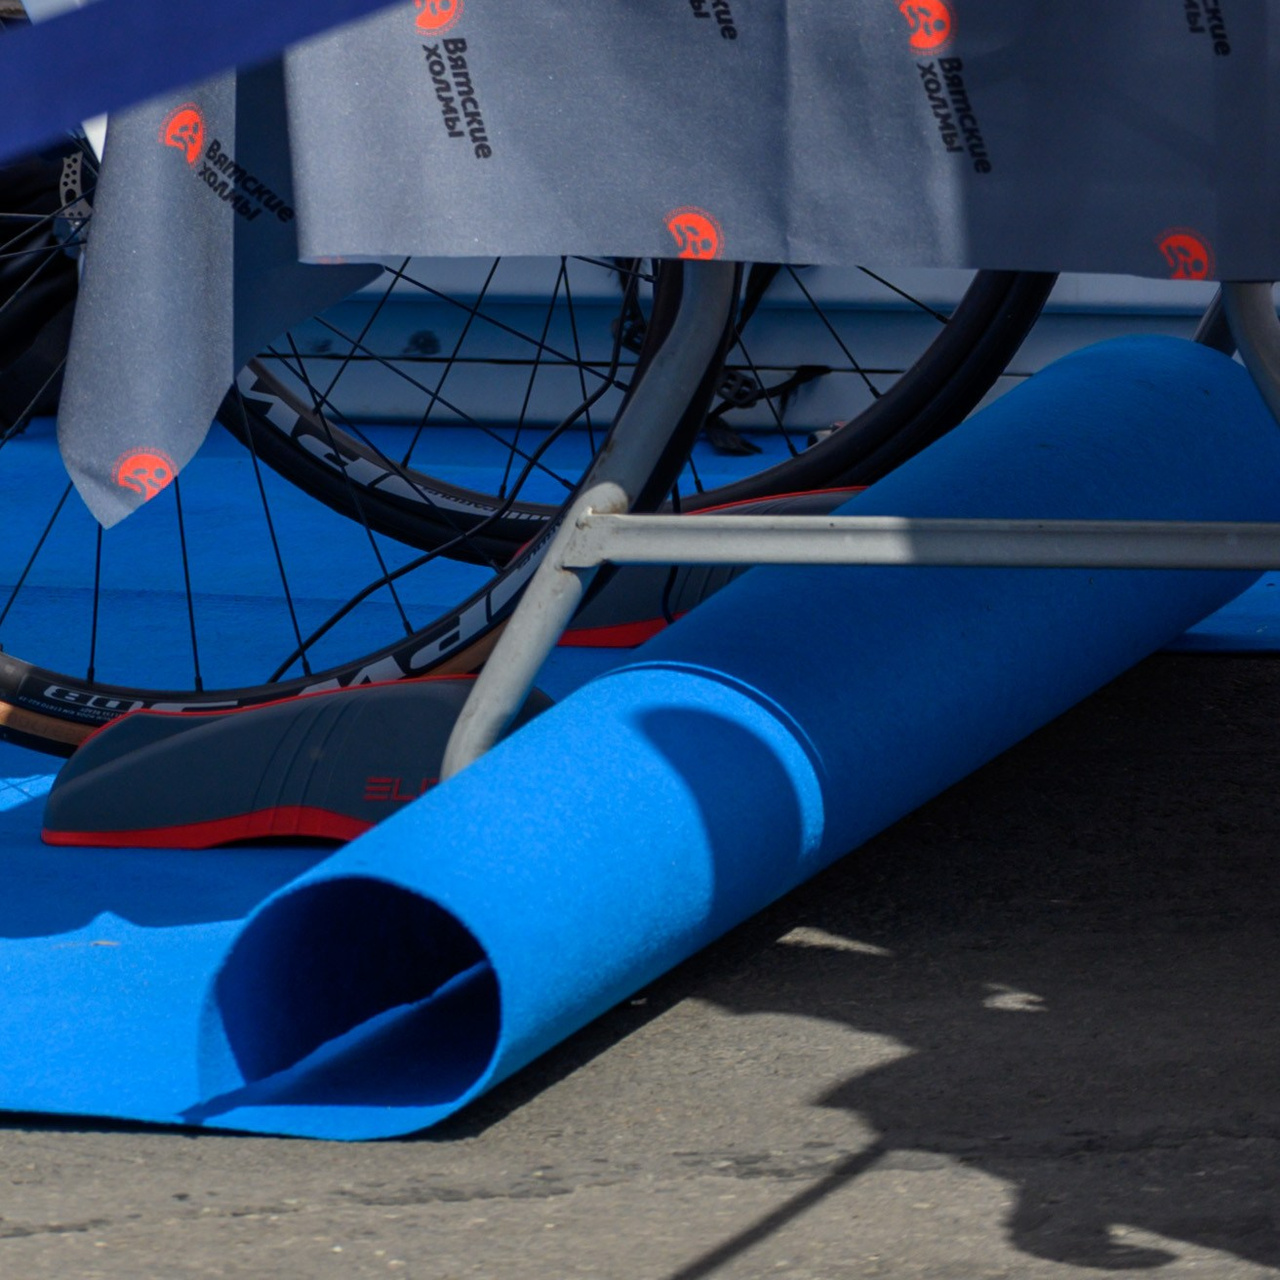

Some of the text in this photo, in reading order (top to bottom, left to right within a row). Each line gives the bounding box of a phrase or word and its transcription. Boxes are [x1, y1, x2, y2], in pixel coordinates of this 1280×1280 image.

[422, 44, 465, 139] холмы
[443, 37, 492, 160] Вятские
[916, 62, 962, 153] холмы
[937, 57, 992, 175] Вятские
[197, 160, 261, 223] холмы
[205, 138, 295, 223] Вятские
